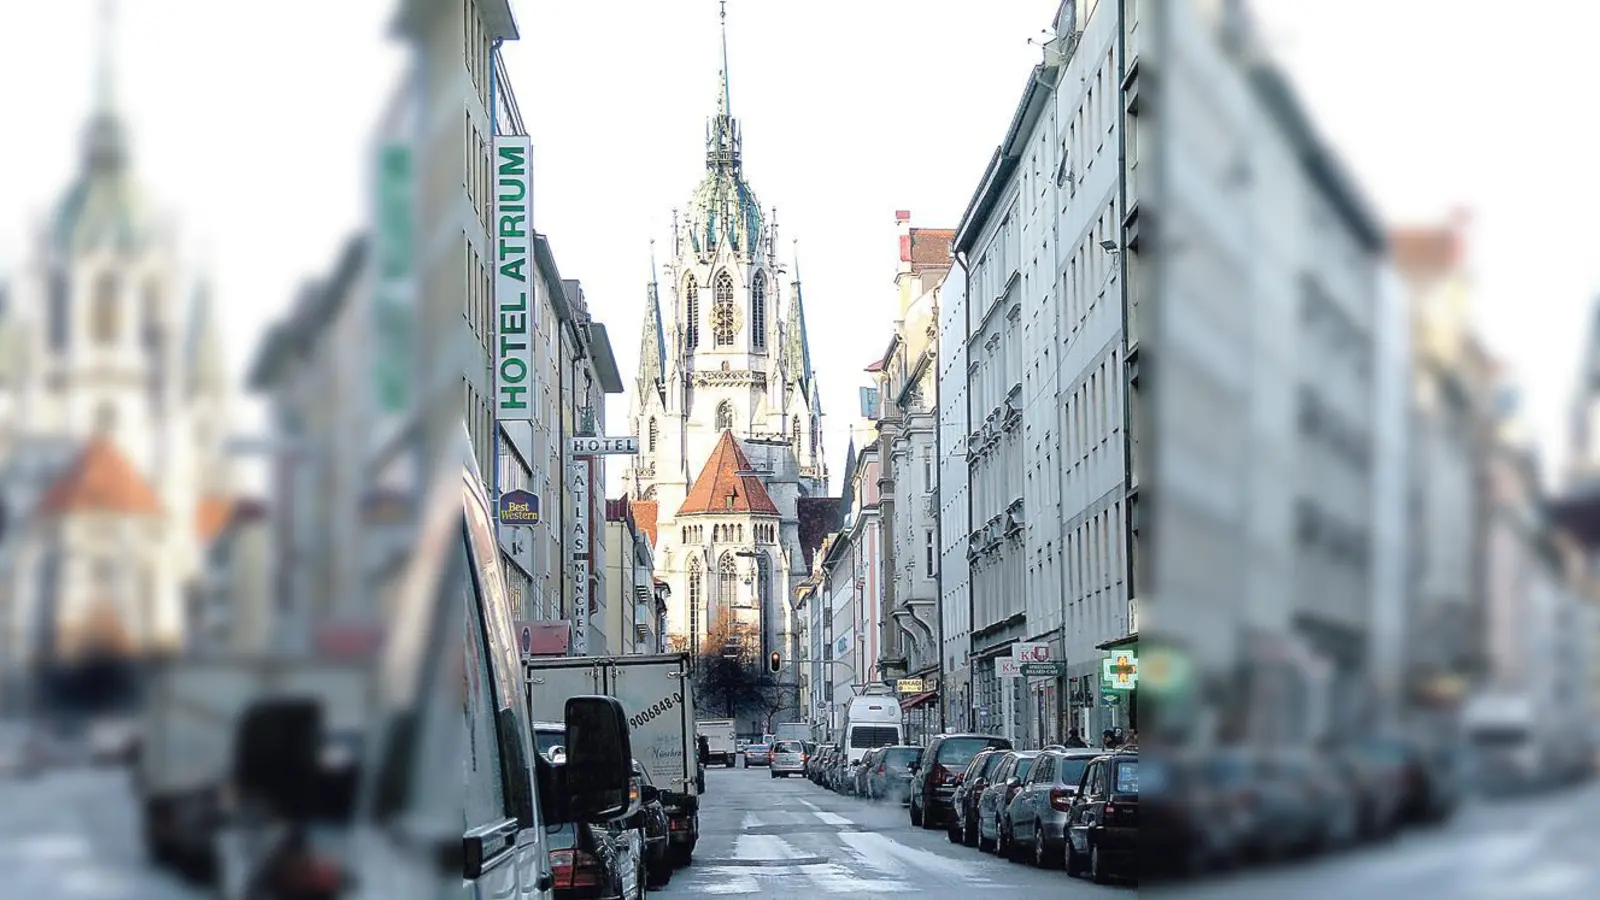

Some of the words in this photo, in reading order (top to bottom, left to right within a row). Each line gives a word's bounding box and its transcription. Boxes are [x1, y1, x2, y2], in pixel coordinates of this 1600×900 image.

[499, 146, 526, 283] ATRIUM
[500, 292, 527, 409] HOTEL
[573, 440, 635, 452] HOTEL
[501, 511, 538, 520] Western
[509, 502, 530, 512] Best
[573, 475, 585, 550] ATLAS
[574, 564, 585, 638] MÜNCHEN
[629, 692, 682, 730] 9006848-0
